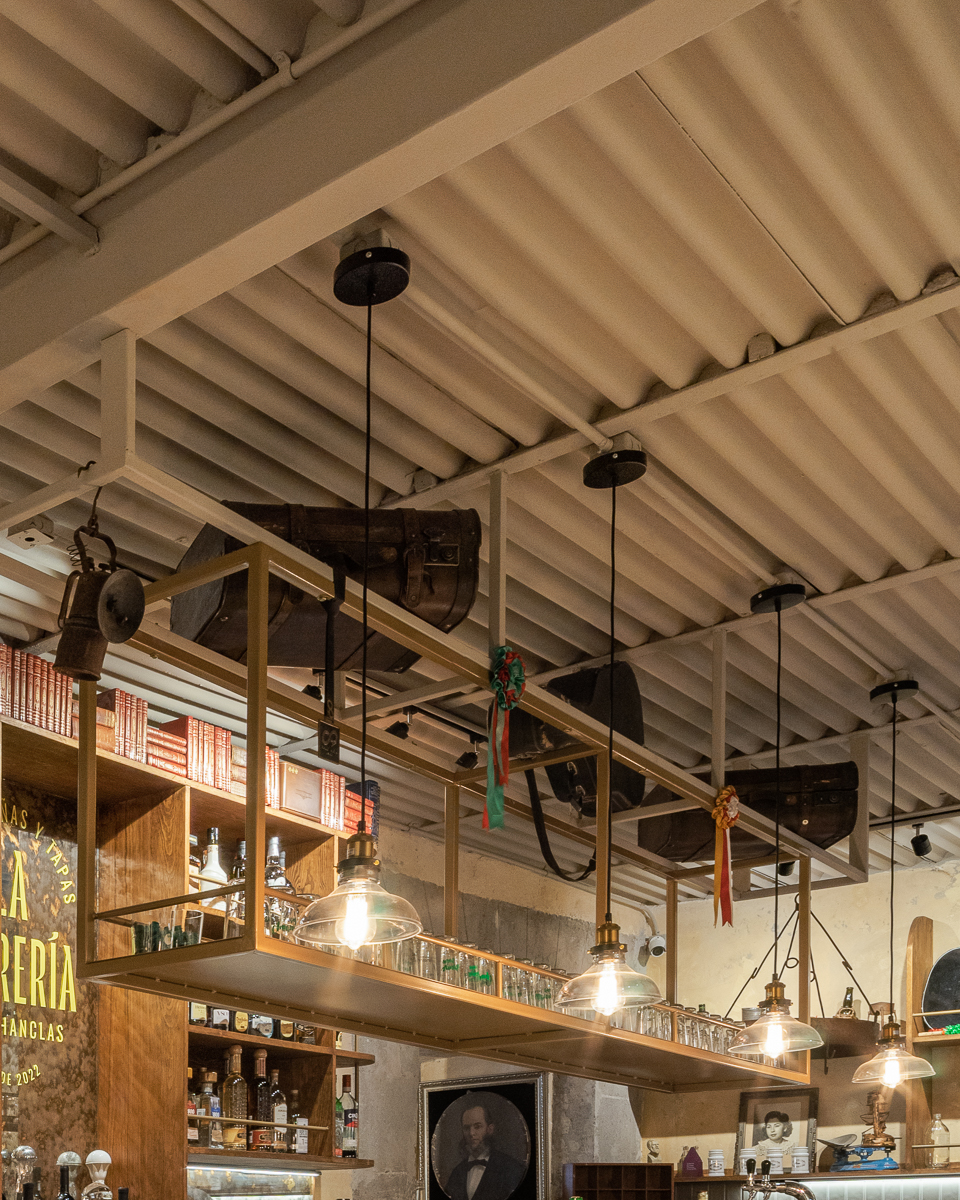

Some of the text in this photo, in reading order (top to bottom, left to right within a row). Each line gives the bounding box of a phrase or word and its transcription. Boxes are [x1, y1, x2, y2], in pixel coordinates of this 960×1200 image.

[1, 798, 77, 905] ÑAS Y TAPAS
[1, 850, 28, 921] A
[1, 931, 77, 1012] RERÍA
[1, 1017, 64, 1043] HANCLAS
[16, 1064, 41, 1086] 2022
